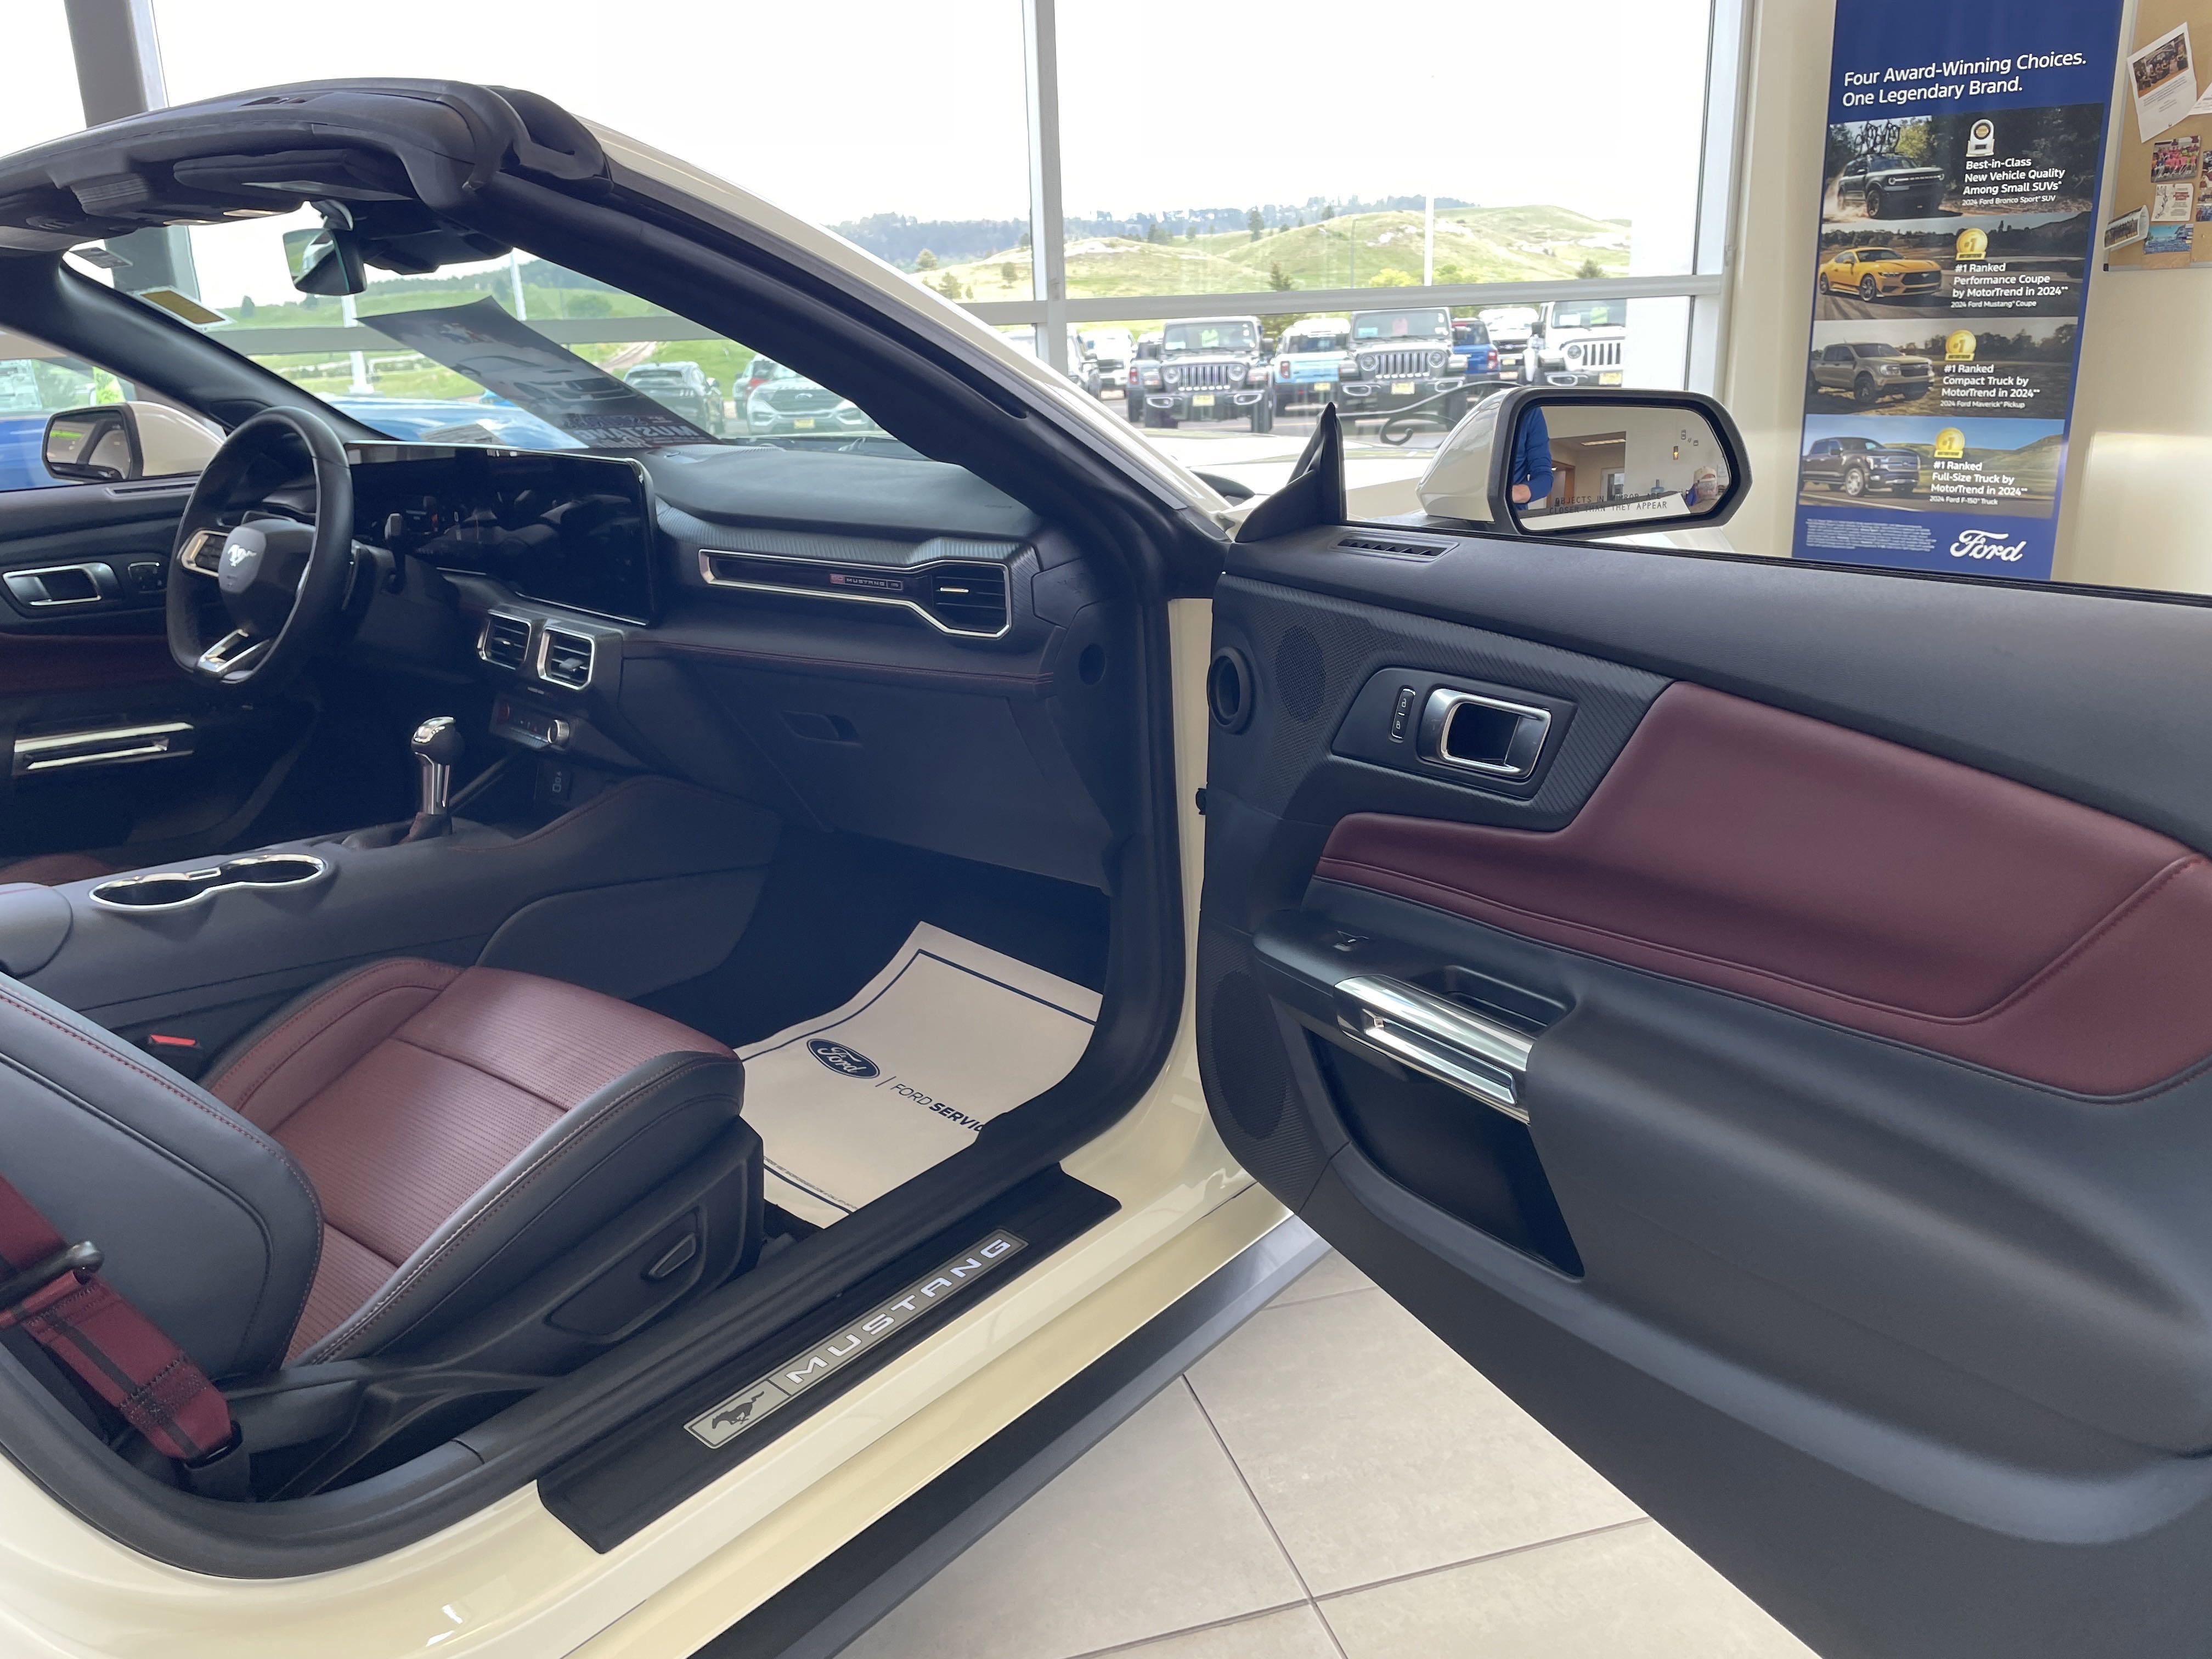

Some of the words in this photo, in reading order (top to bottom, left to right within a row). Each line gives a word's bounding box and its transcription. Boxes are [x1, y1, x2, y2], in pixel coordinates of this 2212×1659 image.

[1844, 71, 1880, 86] Four
[1883, 58, 2011, 83] Award-Winning
[2017, 51, 2086, 70] Choices.
[1842, 92, 1875, 106] One
[1878, 83, 1965, 104] Legendary
[1969, 76, 2023, 95] Brand.
[1966, 158, 2032, 170] Best-in-Class
[1965, 173, 1988, 183] New
[1990, 171, 2025, 181] Vehicle
[2028, 168, 2066, 179] Quality
[1963, 185, 1999, 195] Among
[2001, 183, 2029, 193] Small
[1955, 264, 1967, 273] #1
[1969, 263, 2006, 272] Ranked
[1954, 276, 2016, 285] Performance
[2019, 275, 2051, 285] Coupe
[1953, 289, 1965, 298] by
[1967, 287, 2023, 297] MotorTrend
[2025, 287, 2035, 296] in
[1944, 364, 1956, 373] #1
[1957, 364, 1994, 374] Ranked
[1943, 376, 1985, 386] Compact
[1987, 376, 2014, 385] Truck
[2016, 376, 2029, 387] by
[1942, 388, 1996, 397] MotorTrend
[1998, 388, 2008, 397] in
[1933, 461, 1945, 469] #1
[1947, 461, 1983, 471] Ranked
[1932, 472, 1972, 482] Full-Size
[1974, 474, 2000, 483] Truck
[2002, 475, 2015, 485] by
[1931, 483, 1985, 494] MotorTrend
[1987, 486, 1995, 495] in
[1555, 496, 1592, 505] OBJECTS
[1549, 506, 1579, 514] CLOSER
[1636, 501, 1668, 510] APPEAR
[1950, 529, 2027, 562] Ford
[847, 578, 885, 586] MUSTANG
[817, 1047, 867, 1074] Ford
[890, 1084, 932, 1105] FORD
[785, 1239, 1011, 1384] MUSTANG
